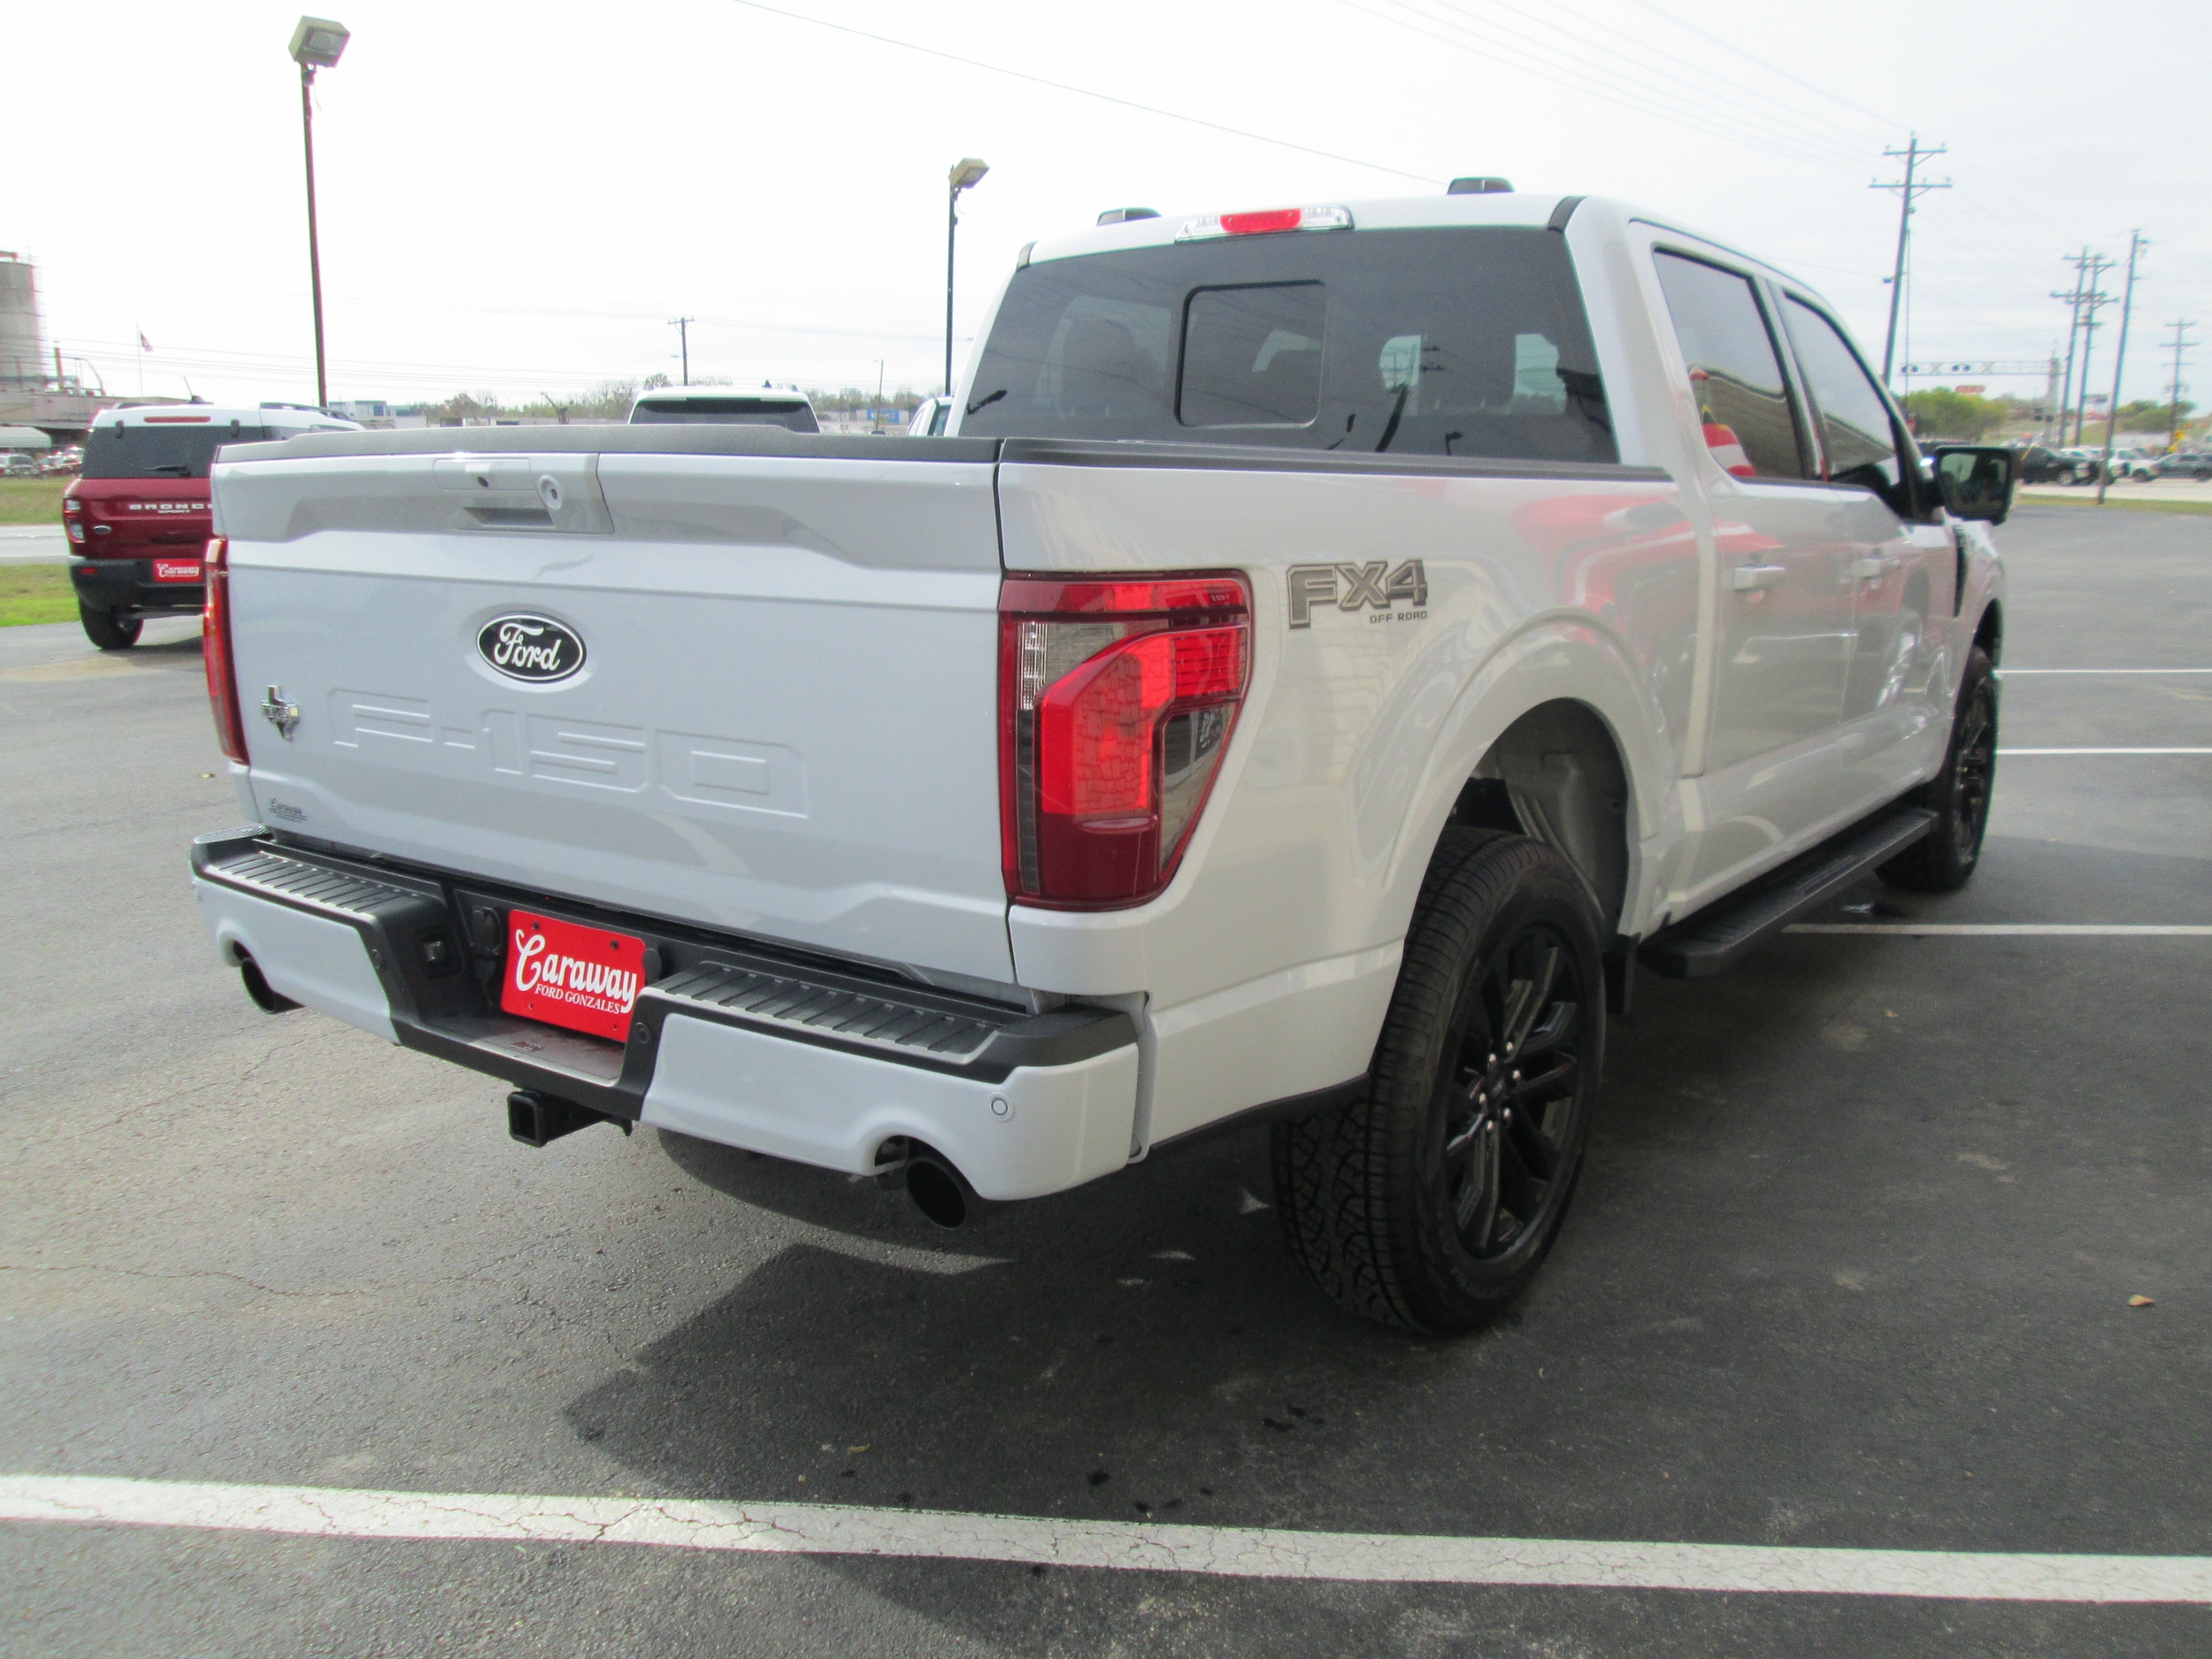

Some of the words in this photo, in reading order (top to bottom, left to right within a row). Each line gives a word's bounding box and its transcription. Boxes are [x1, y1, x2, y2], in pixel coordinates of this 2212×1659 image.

[157, 564, 200, 578] Caraway
[1286, 559, 1427, 629] FX4
[1370, 614, 1394, 624] OFF
[1397, 611, 1427, 622] ROAD
[494, 622, 562, 672] Ford
[327, 688, 809, 818] F-150
[515, 928, 637, 1014] Caraway
[534, 983, 564, 1001] FORD
[565, 991, 620, 1015] GONZALES
